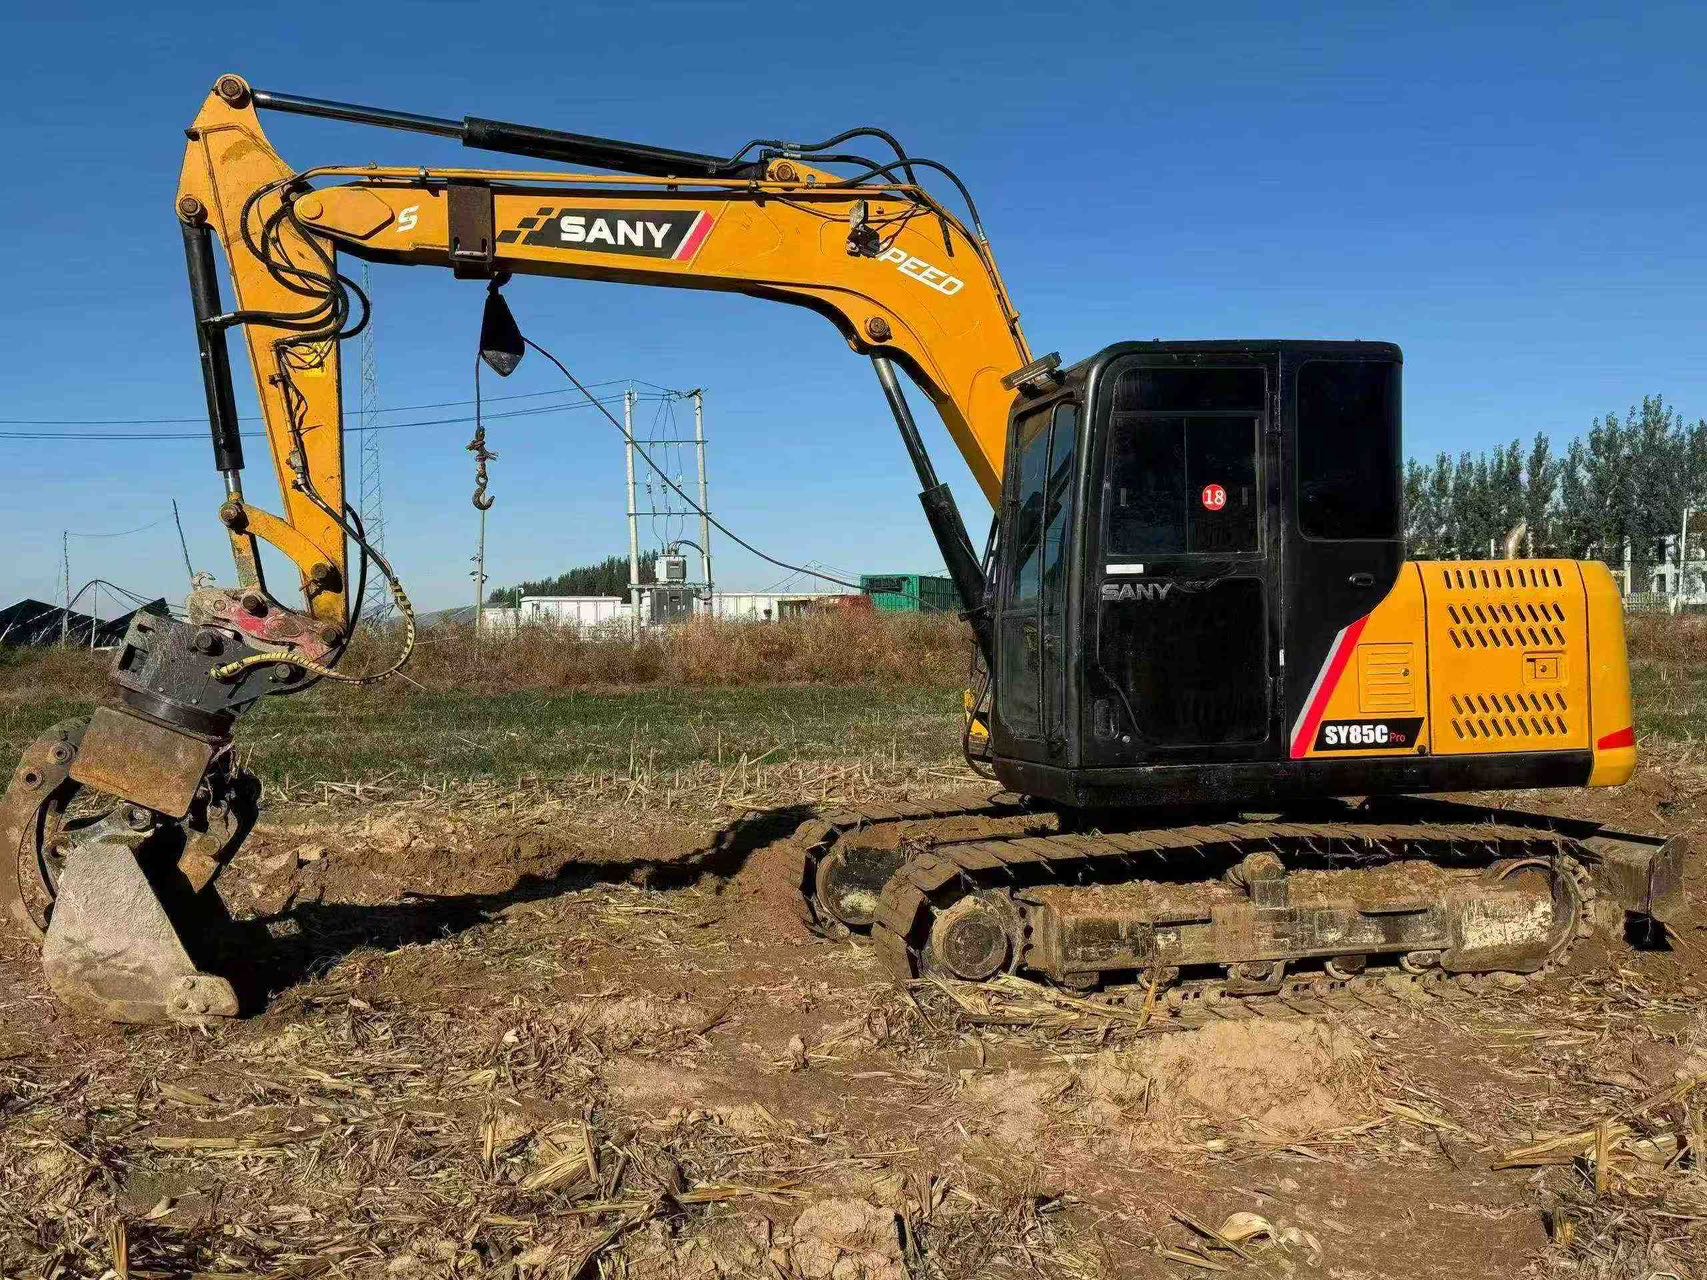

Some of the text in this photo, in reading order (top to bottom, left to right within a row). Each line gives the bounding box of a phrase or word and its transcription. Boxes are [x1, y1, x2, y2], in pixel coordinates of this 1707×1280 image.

[559, 215, 673, 249] SANY
[876, 241, 965, 296] PEED
[1205, 489, 1225, 505] 18
[1101, 583, 1174, 601] SANY
[1324, 724, 1406, 745] SY85C Pro
